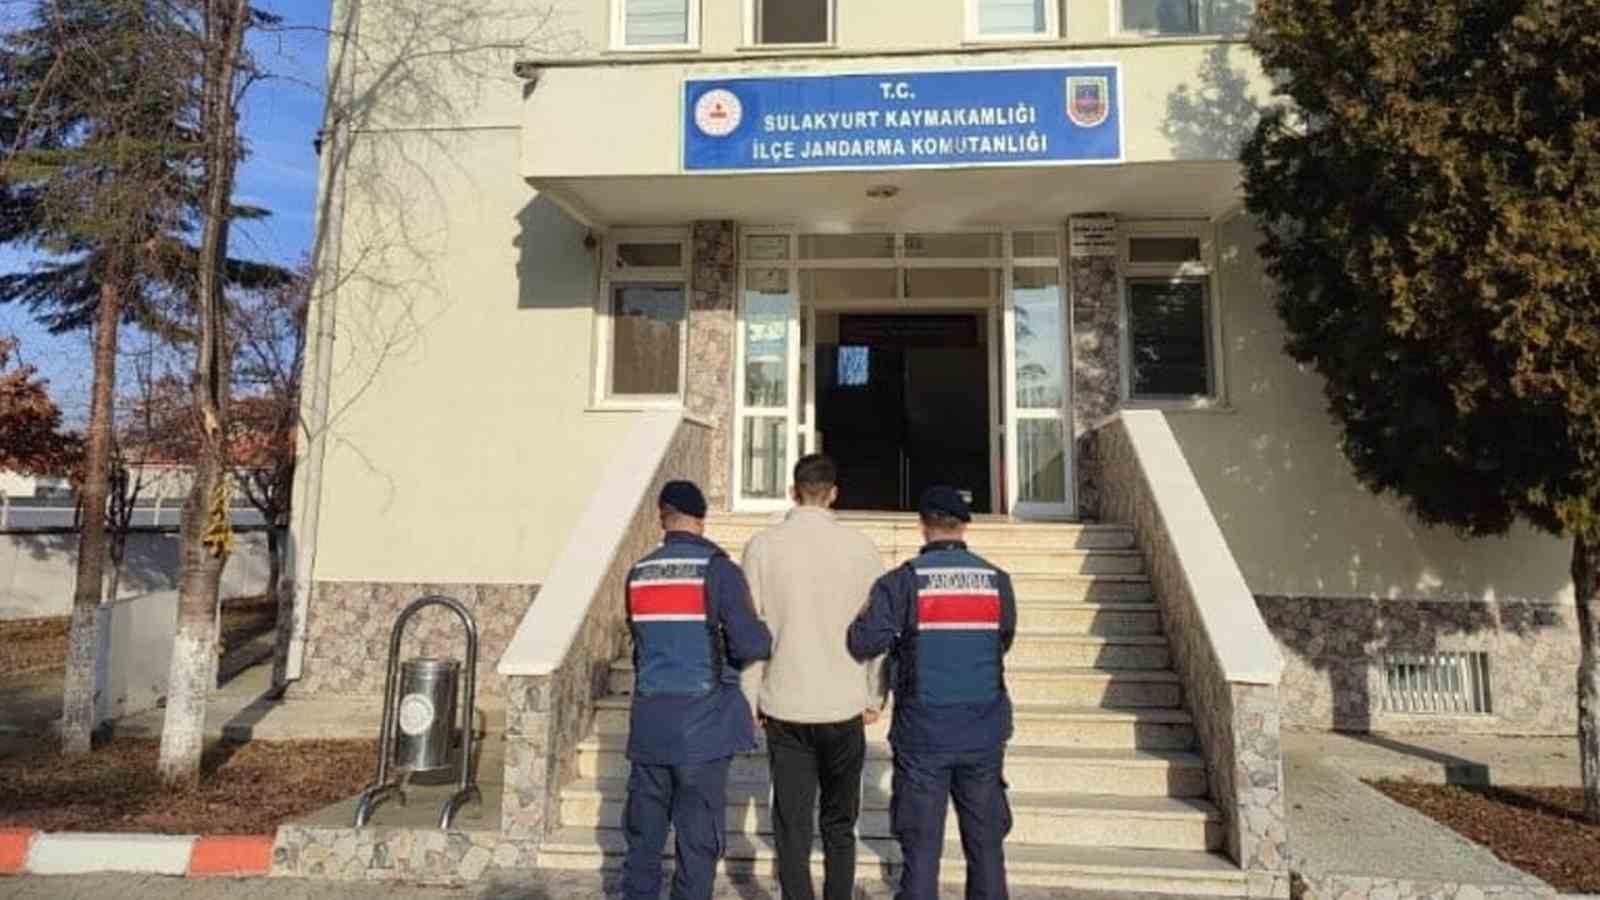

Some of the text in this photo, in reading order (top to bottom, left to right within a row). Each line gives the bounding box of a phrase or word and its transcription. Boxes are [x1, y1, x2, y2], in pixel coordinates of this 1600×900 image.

[880, 82, 916, 99] T.C.
[763, 102, 1036, 132] SULAKYURT KAYMAKAMLIĞI
[752, 131, 1048, 162] İLÇE JANDARMA KOMUTANLIĞI
